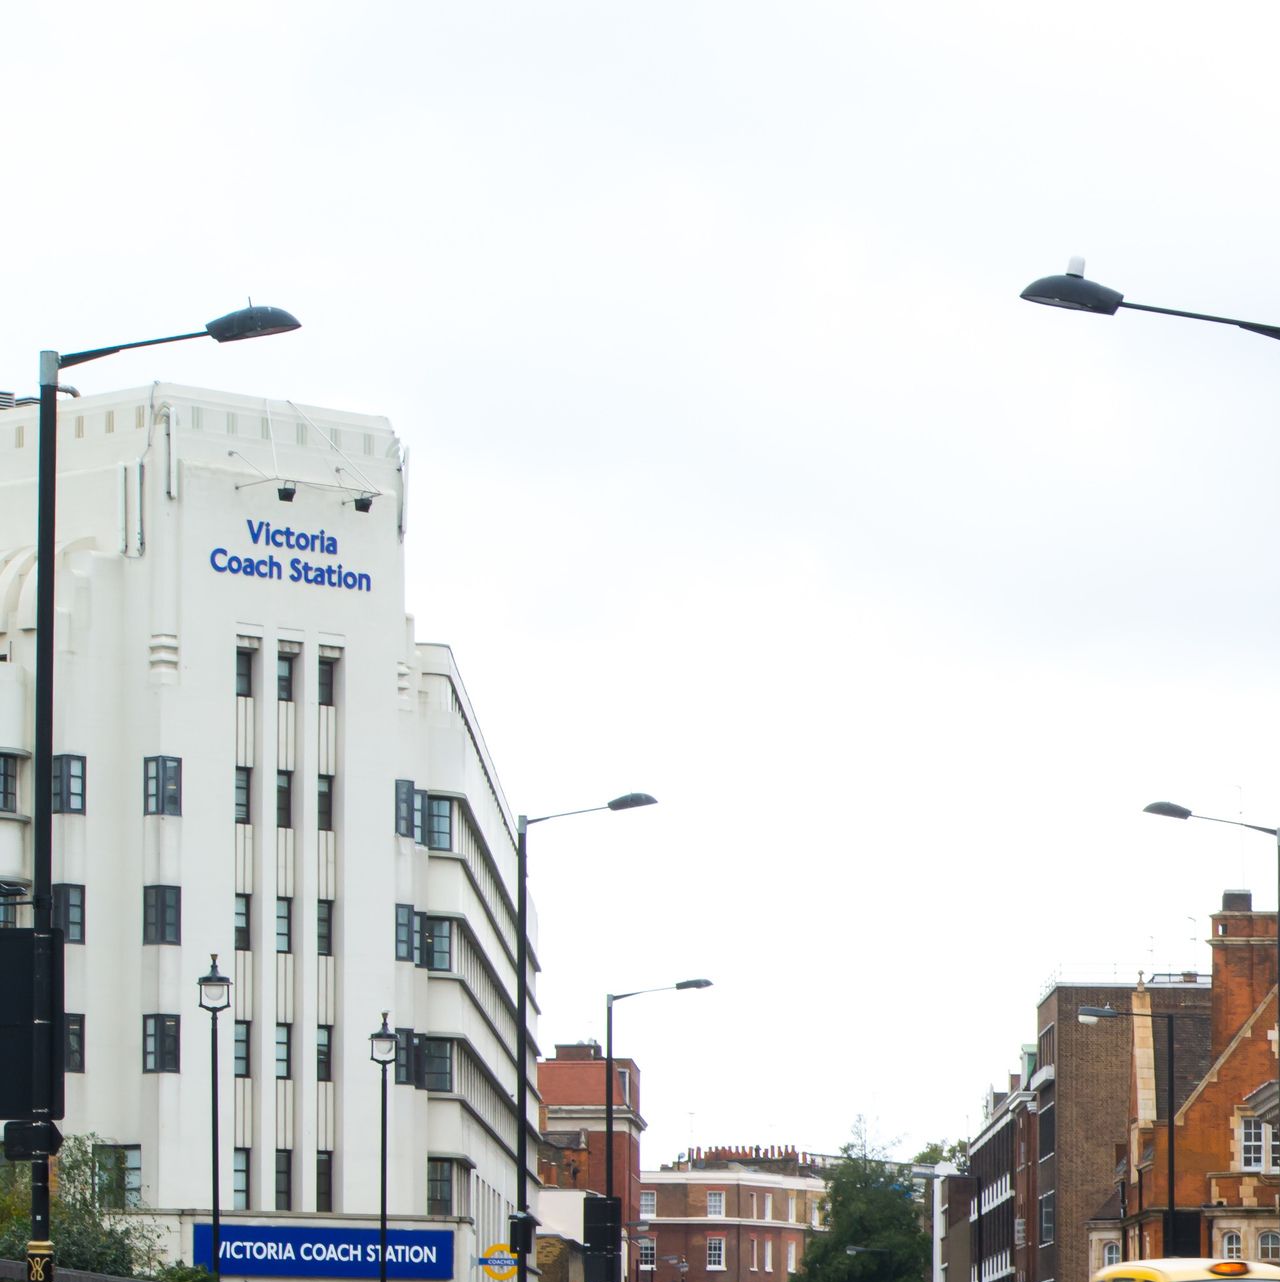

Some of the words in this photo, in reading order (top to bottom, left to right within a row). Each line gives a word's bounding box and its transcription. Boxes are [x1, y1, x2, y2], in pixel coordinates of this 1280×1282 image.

[246, 519, 338, 555] Victoria
[210, 548, 282, 580] Coach
[289, 558, 371, 592] Station
[300, 1243, 362, 1262] COACH
[366, 1244, 437, 1264] STATION
